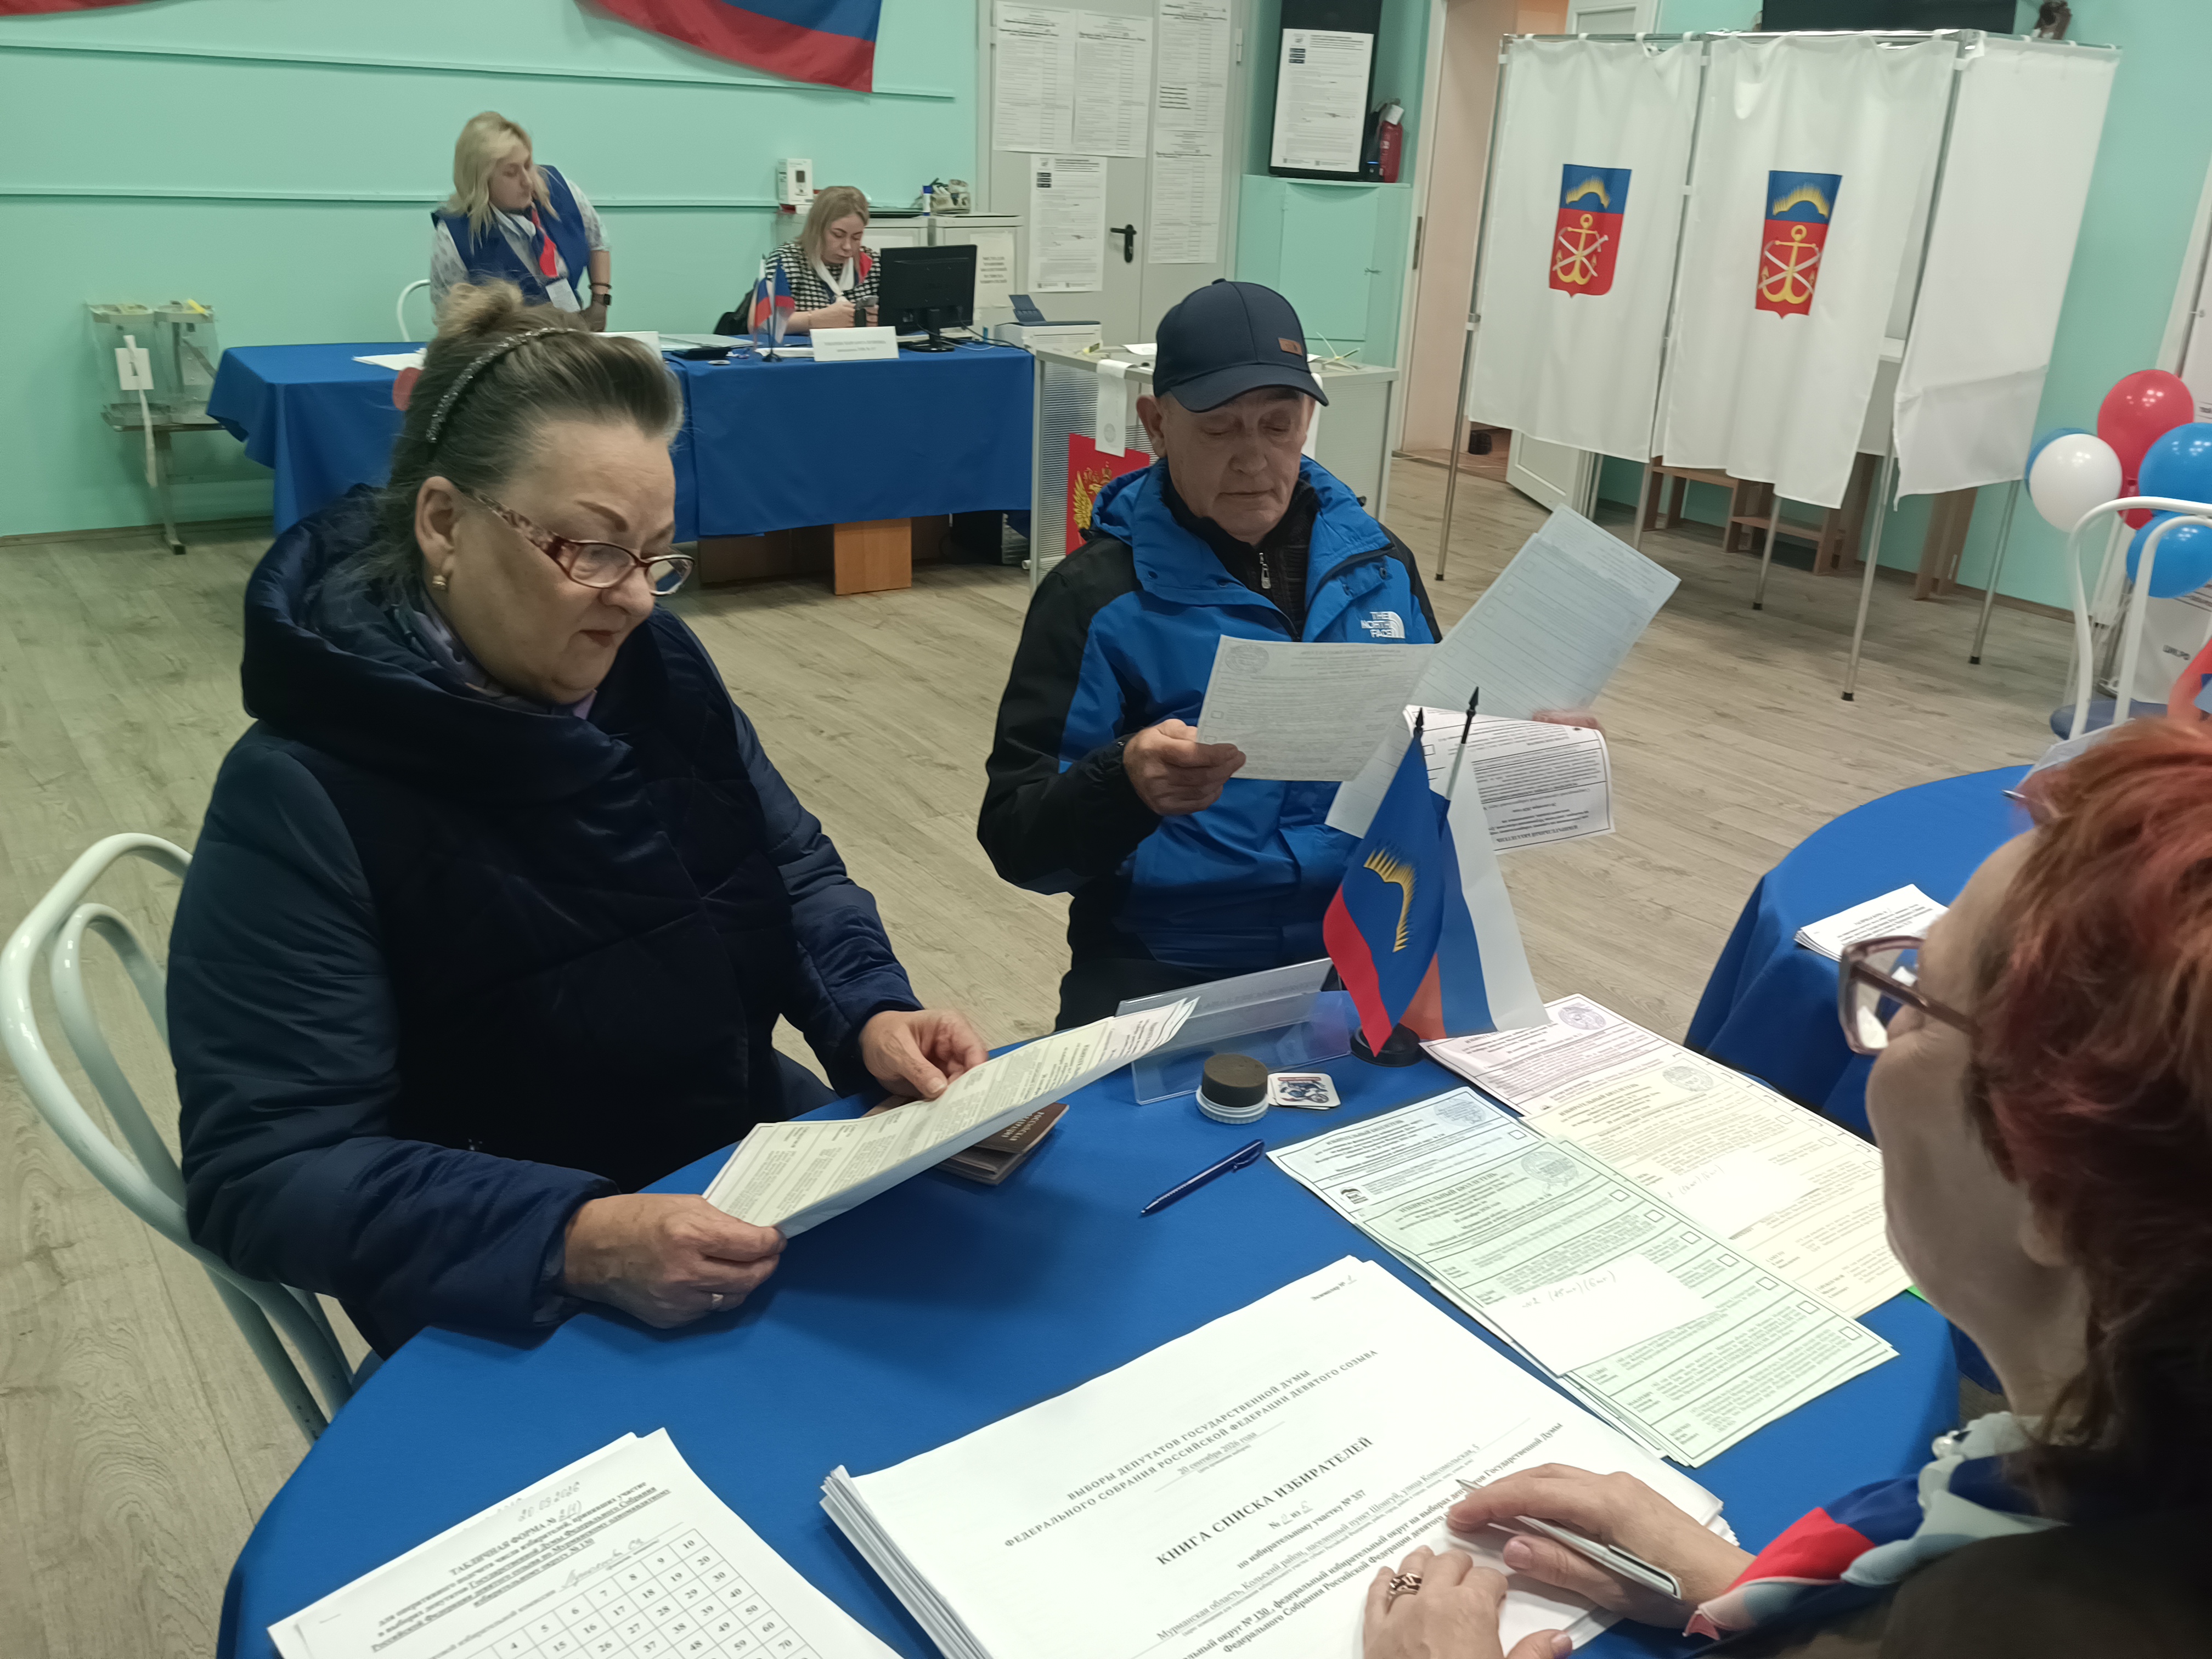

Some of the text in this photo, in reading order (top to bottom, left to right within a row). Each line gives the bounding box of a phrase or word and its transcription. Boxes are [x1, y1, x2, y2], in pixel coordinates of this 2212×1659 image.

[1361, 620, 1391, 629] NORTH
[1369, 611, 1390, 620] THE
[1370, 629, 1392, 637] FACE
[1005, 1351, 1377, 1545] ФЕДЕРАЛЬНОГО СОБРАНИЯ РОССИЙСКОЙ ФЕДЕРАЦИИ ДЕВЯТОГО СОЗЫВА
[1067, 1370, 1310, 1499] ВЫБОРЫ ДЕПУТАТОВ ГОСУДАРСТВЕННОЙ ДУМЫ
[1177, 1466, 1190, 1475] 20
[1189, 1451, 1222, 1469] сентября
[1239, 1432, 1260, 1442] года
[1156, 1532, 1211, 1564] КНИГА
[1212, 1496, 1274, 1531] СПИСКА
[1274, 1437, 1372, 1497] ИЗБИРАТЕЛЕЙ
[1217, 1625, 1242, 1642] округ
[1273, 1571, 1328, 1607] федеральный
[1328, 1536, 1387, 1573] избирательный
[1387, 1522, 1409, 1538] округ
[1419, 1498, 1451, 1517] выборах
[1484, 1438, 1542, 1476] Государственной
[1540, 1423, 1562, 1440] Думы
[1237, 1560, 1249, 1568] по
[1249, 1523, 1312, 1561] избирательному
[1312, 1505, 1343, 1525] участку
[1350, 1489, 1365, 1500] 357
[540, 1624, 549, 1633] 5
[682, 1540, 695, 1549] 10
[1157, 1609, 1212, 1643] Мурманская
[1241, 1564, 1284, 1592] Кольский
[1305, 1524, 1351, 1551] населенный
[1348, 1511, 1374, 1526] пункт
[1400, 1480, 1423, 1495] улица
[1223, 1615, 1283, 1651] Федерального
[1283, 1589, 1324, 1615] Собрания
[1322, 1561, 1369, 1590] Российской
[1368, 1536, 1411, 1562] Федерации
[1411, 1516, 1448, 1538] девятого
[552, 1555, 710, 1652] 15 16 17 18 19 20
[597, 1572, 726, 1652] 26 27 28 29 30
[643, 1588, 742, 1653] 37 38 39 40
[690, 1605, 759, 1651] 48 49 50
[733, 1622, 775, 1651] 59 60
[777, 1639, 793, 1650] 70
